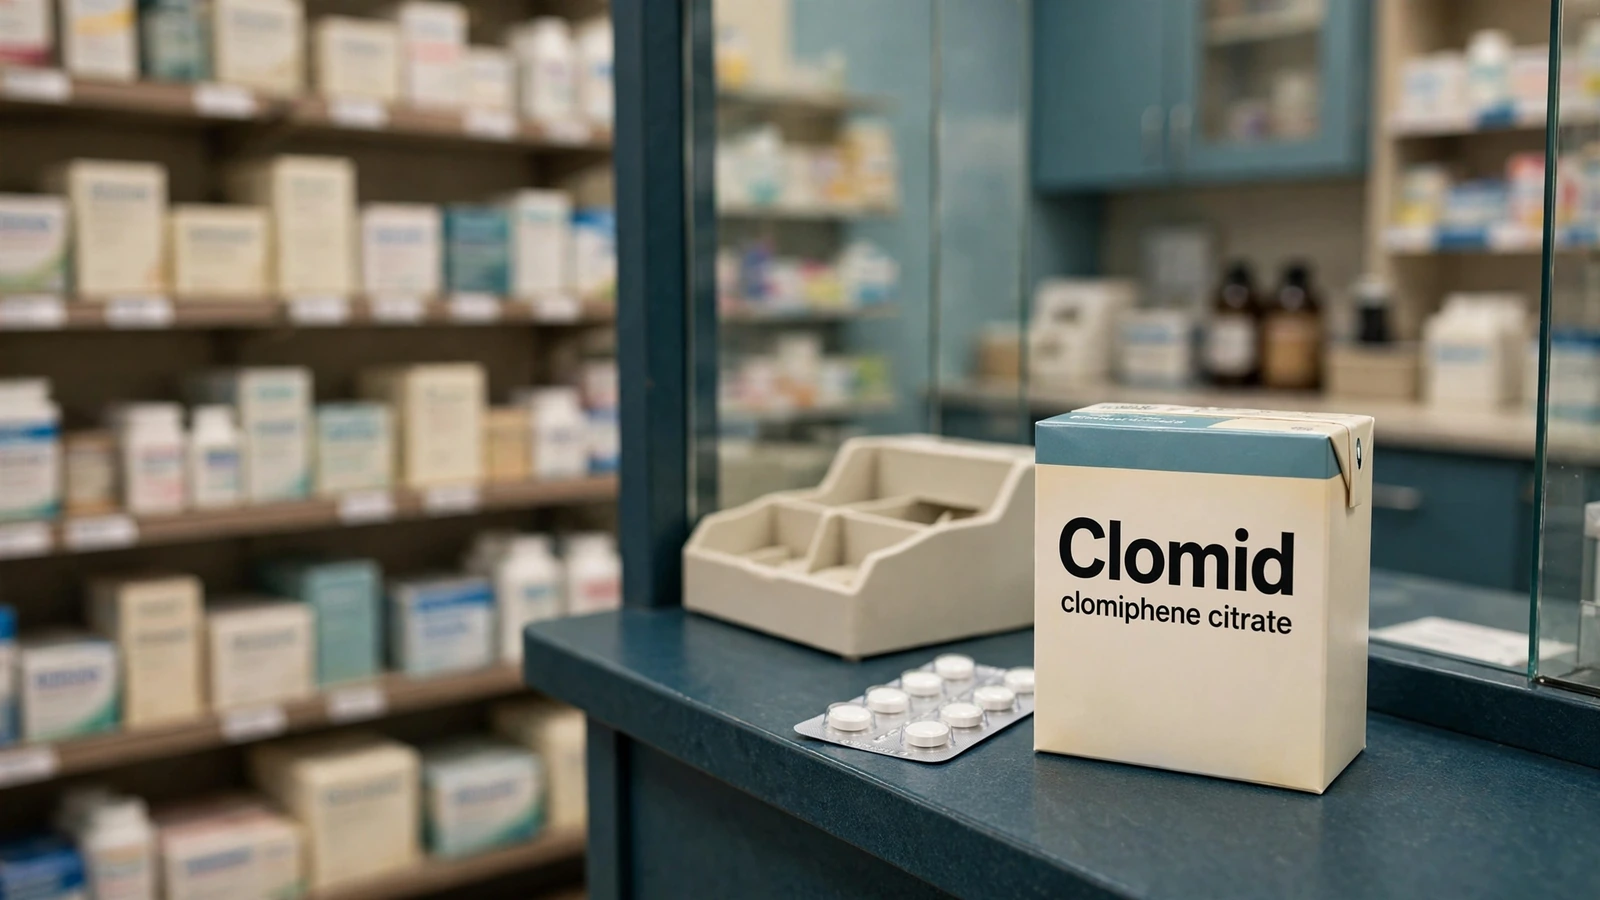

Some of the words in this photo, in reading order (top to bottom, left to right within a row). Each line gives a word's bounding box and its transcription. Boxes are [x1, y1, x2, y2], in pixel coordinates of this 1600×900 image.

[1059, 517, 1295, 596] Clomid
[1061, 591, 1201, 625] clomiphene
[1208, 604, 1292, 635] citrate
